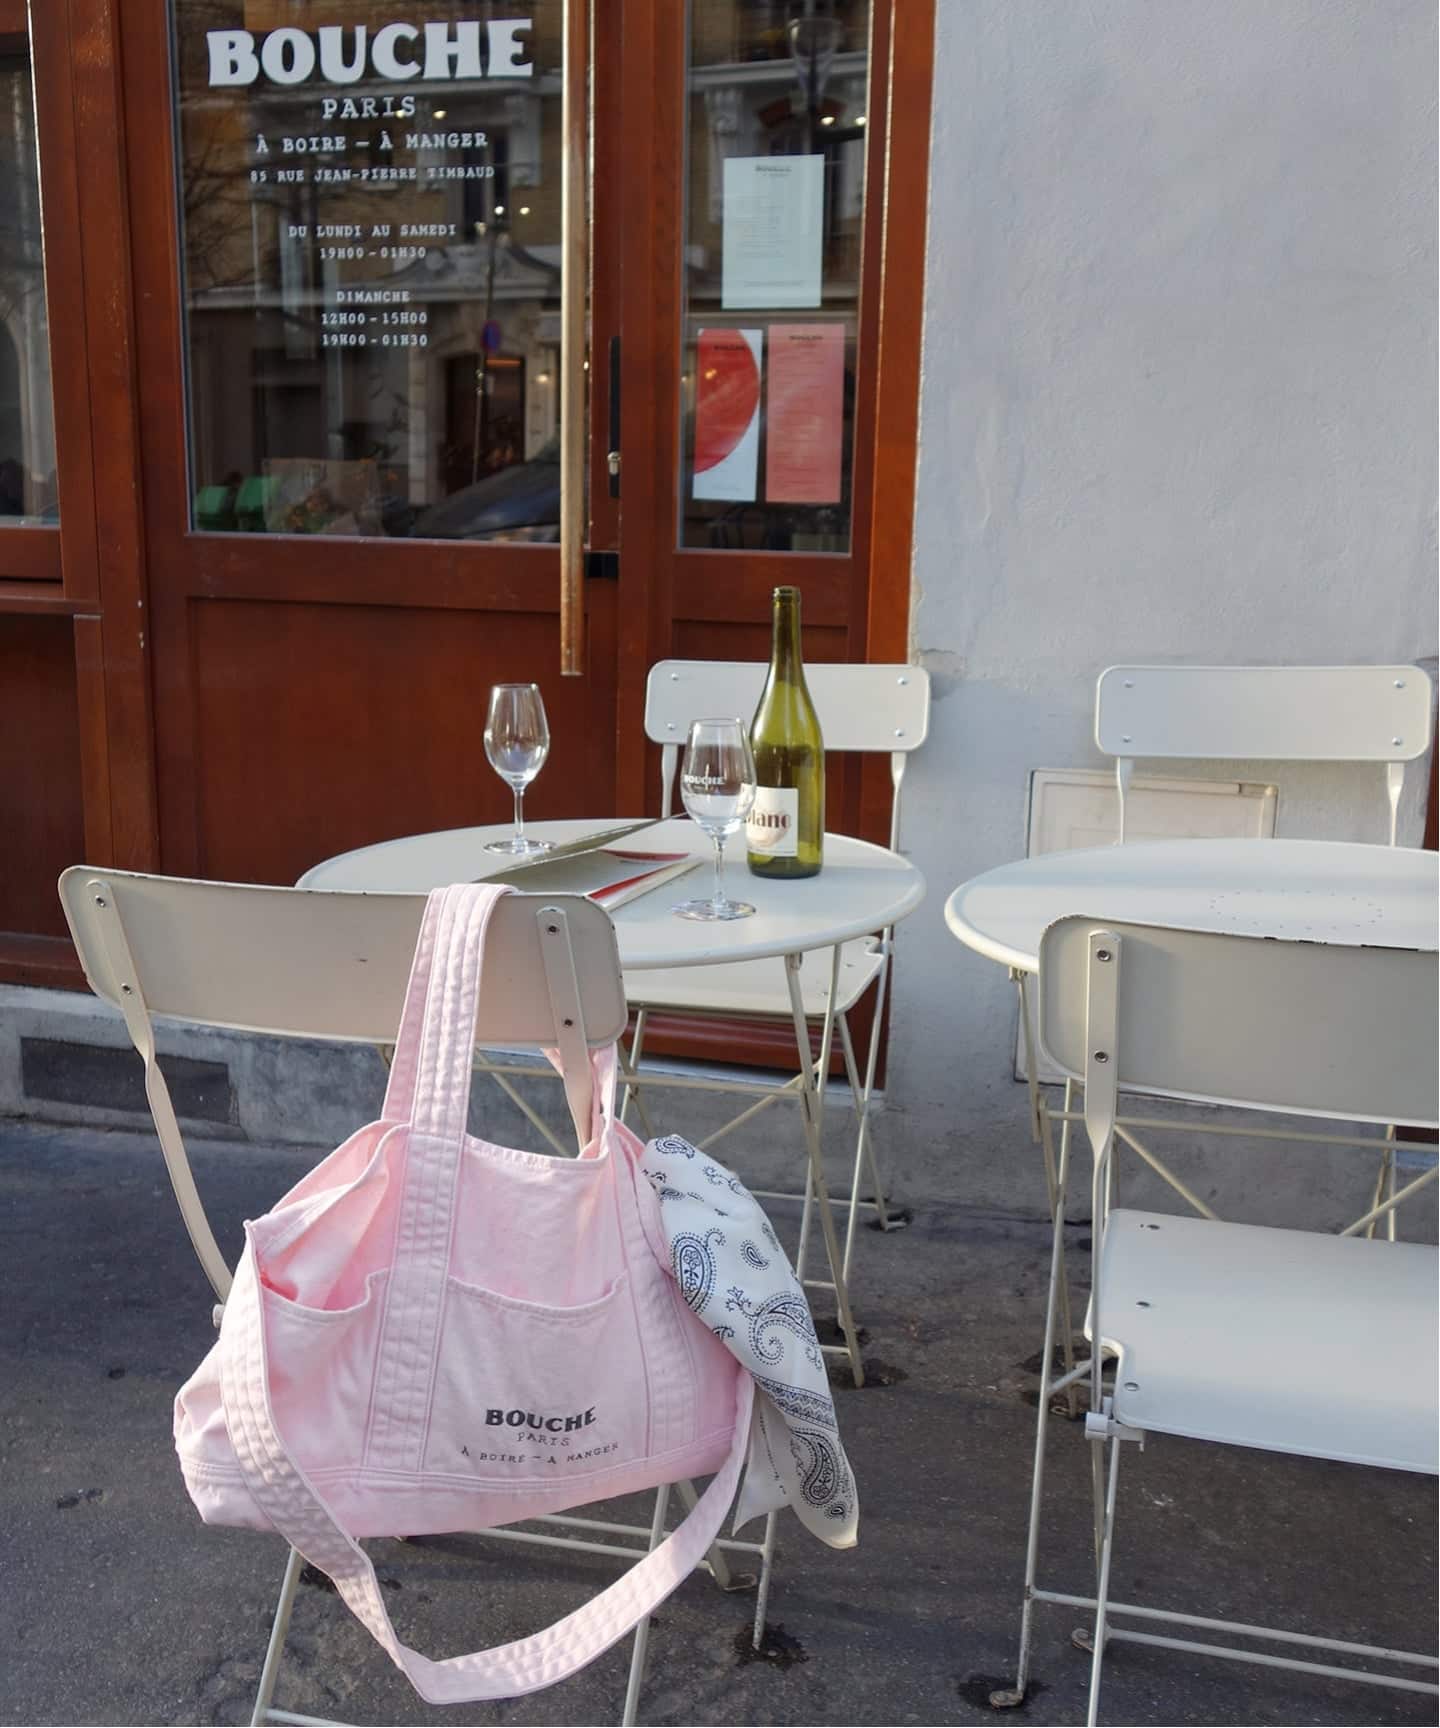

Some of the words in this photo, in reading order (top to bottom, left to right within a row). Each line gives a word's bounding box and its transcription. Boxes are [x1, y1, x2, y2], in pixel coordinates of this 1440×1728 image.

[206, 18, 533, 87] BOUCHE
[322, 96, 417, 120] PARIS
[256, 133, 270, 154] À
[282, 135, 347, 154] BOIRE
[379, 130, 394, 150] À
[405, 132, 489, 149] MANGER
[250, 169, 268, 183] 85
[277, 169, 305, 182] RUE
[314, 166, 417, 182] JEAN-PIERRE
[427, 166, 495, 179] TIMBAUD
[288, 225, 307, 238] DU
[317, 225, 362, 238] LUNDI
[371, 224, 390, 237] AU
[400, 224, 456, 237] SAMEDI
[336, 291, 411, 303] DIMANCHE
[485, 1406, 597, 1432] BOUCHE
[517, 1432, 571, 1446] PARIS
